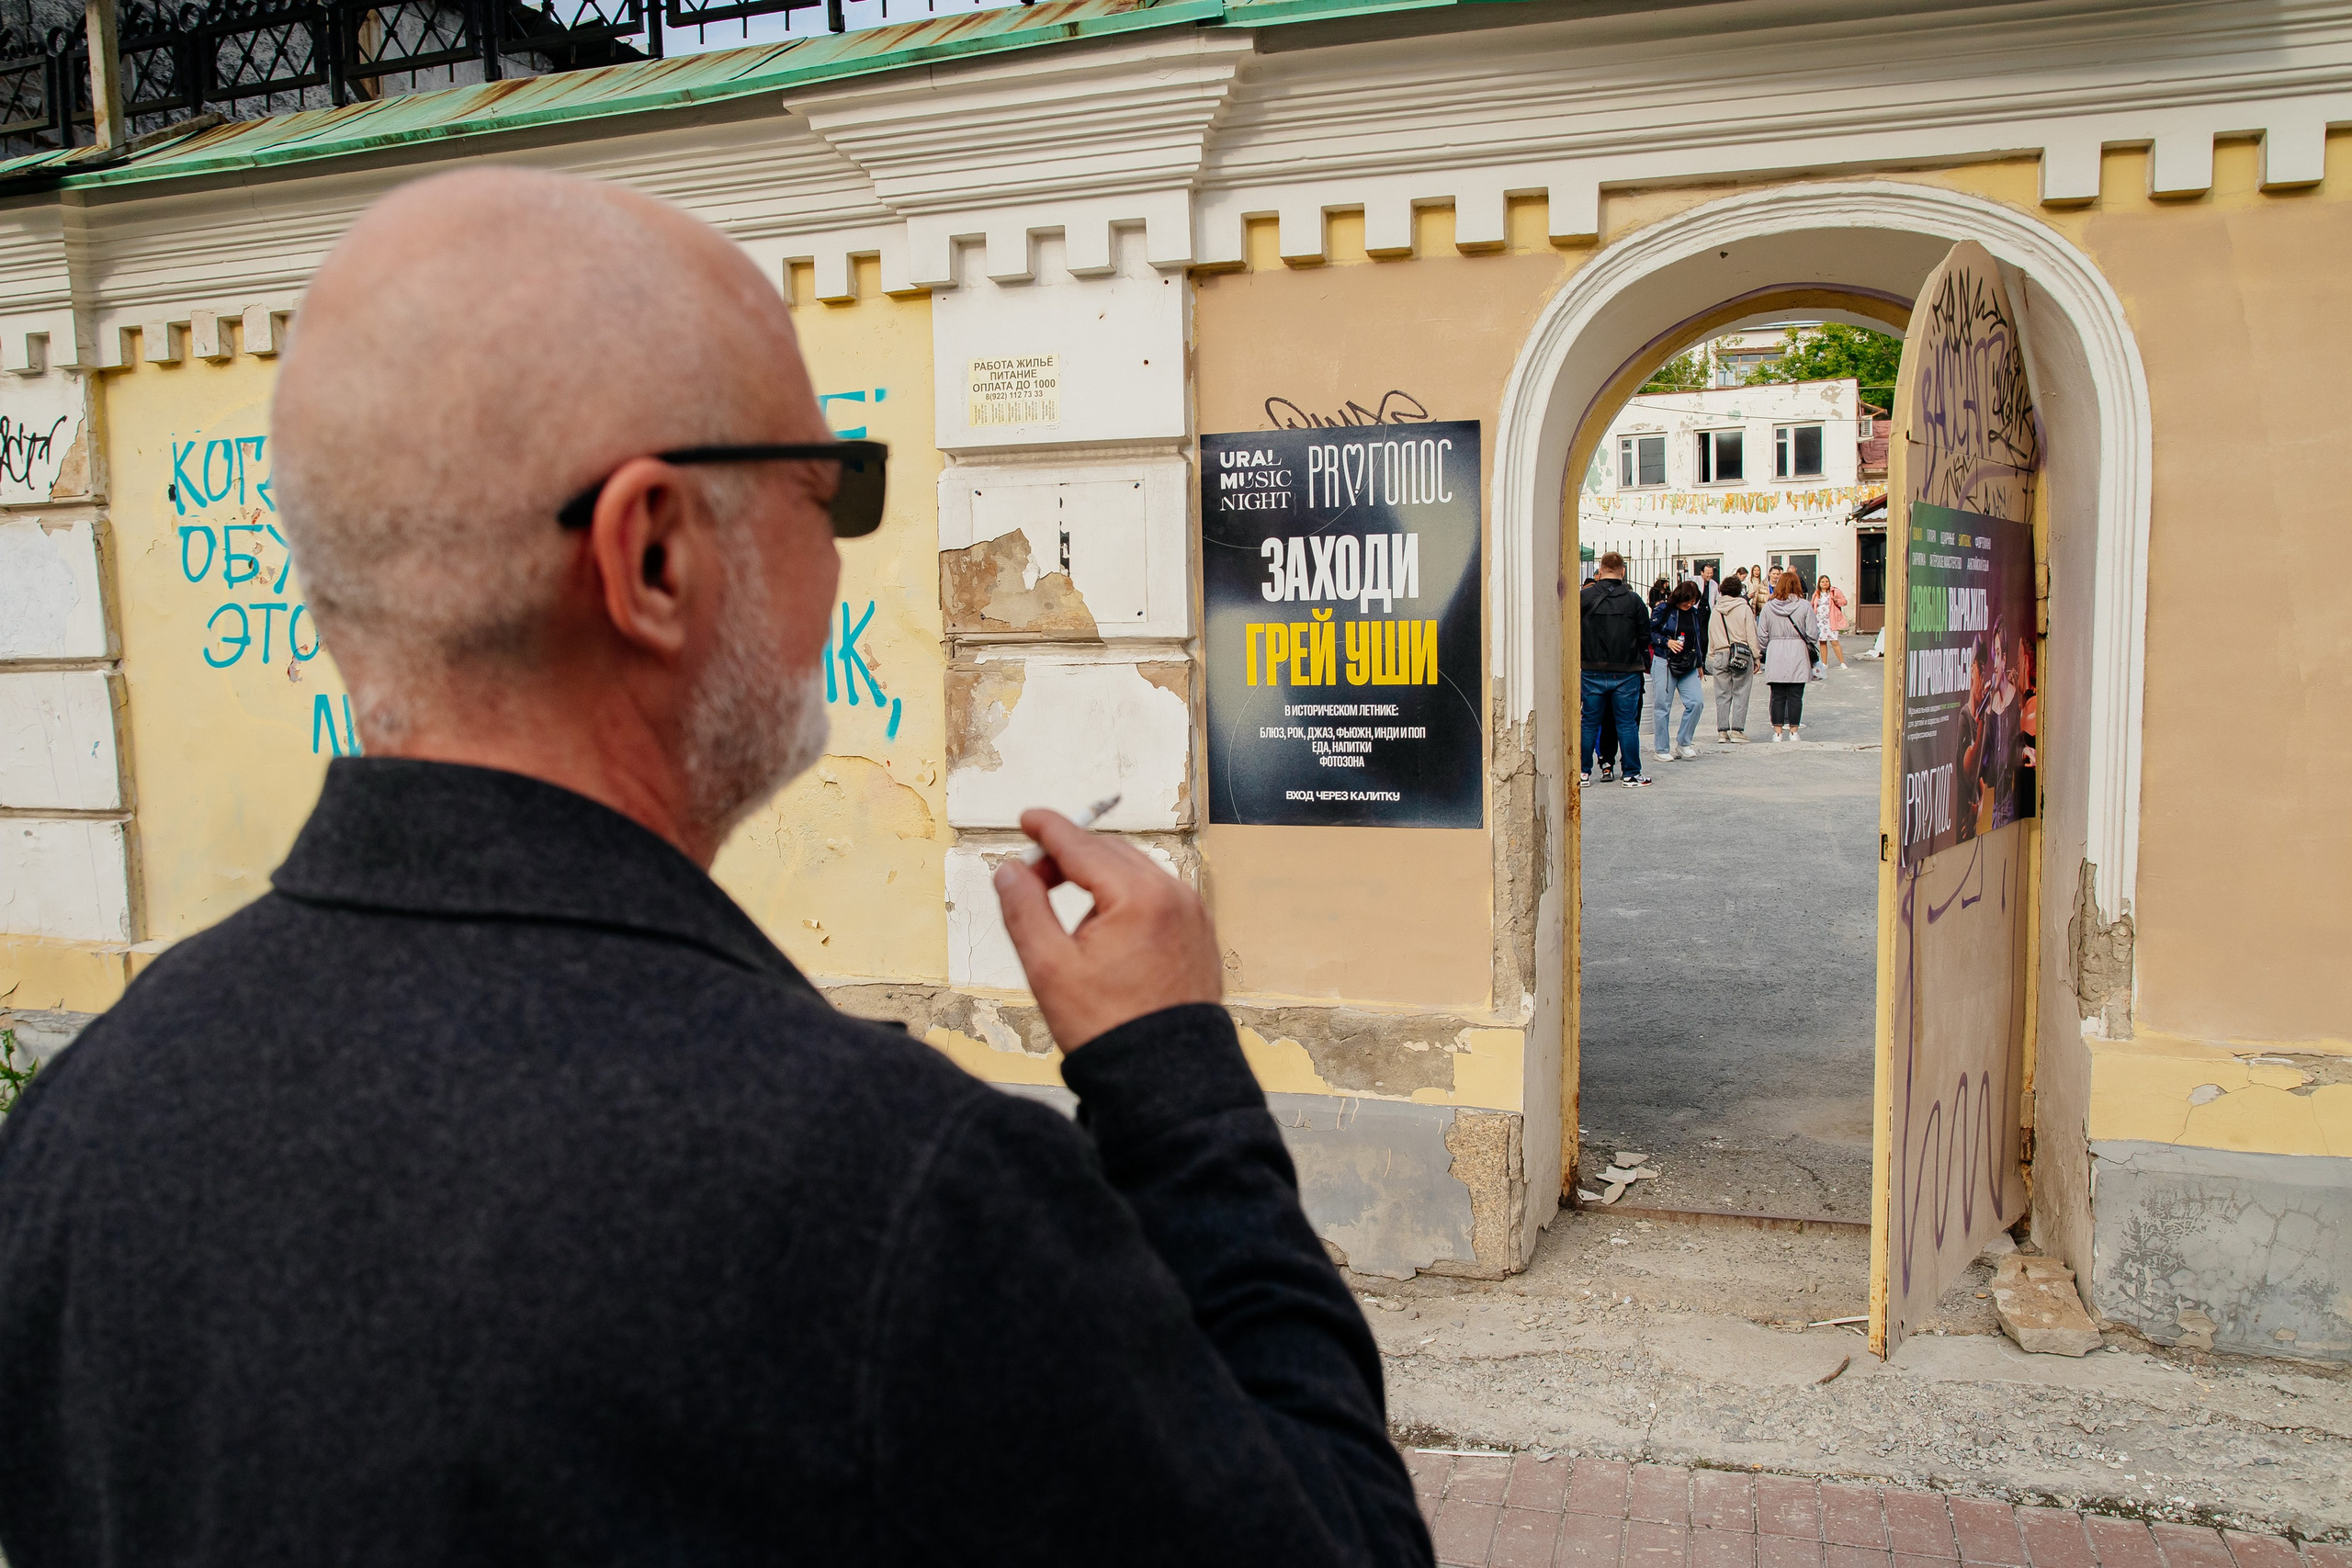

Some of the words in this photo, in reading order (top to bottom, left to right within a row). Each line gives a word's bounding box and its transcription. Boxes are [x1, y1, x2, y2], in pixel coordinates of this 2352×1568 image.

[974, 360, 1013, 371] РАБОТА
[1016, 355, 1053, 368] ЖИЛЬЁ
[989, 369, 1037, 380] ПИТАНИЕ
[972, 381, 1013, 392] ОПЛАТА
[1015, 380, 1030, 391] ДО
[1033, 379, 1056, 389] 1000
[985, 392, 1007, 401] 8(922)
[1219, 449, 1283, 468] URAL
[1220, 469, 1293, 491] MUSIC
[1219, 491, 1292, 512] NIGHT
[1261, 533, 1419, 614] ЗАХОДИ
[1948, 587, 1989, 632] ВЫРАЖАТЬ
[203, 603, 321, 669] ЭТО
[1245, 607, 1337, 686] ГРЕЙ
[1345, 619, 1439, 686] УШИ
[1908, 650, 1917, 698] И
[1284, 705, 1292, 716] В
[1292, 704, 1358, 716] ИСТОРИЧЕСКОМ
[1359, 704, 1399, 716] ЛЕТНИКЕ:
[1260, 728, 1287, 740] БЛЮЗ,
[1287, 728, 1306, 740] РОК,
[1307, 728, 1335, 740] ДЖАЗ,
[1336, 728, 1374, 739] ФЬЮЖН,
[1374, 728, 1399, 740] ИНДИ
[1400, 727, 1408, 739] И
[1408, 727, 1426, 739] ПОП
[1312, 742, 1331, 754] ЕДА,
[1332, 741, 1372, 753] НАПИТКИ
[1319, 756, 1364, 768] ФОТОЗОНА
[1286, 791, 1314, 802] ВХОД
[1316, 791, 1349, 801] ЧЕРЕЗ
[1350, 791, 1400, 802] КАЛИТКУ
